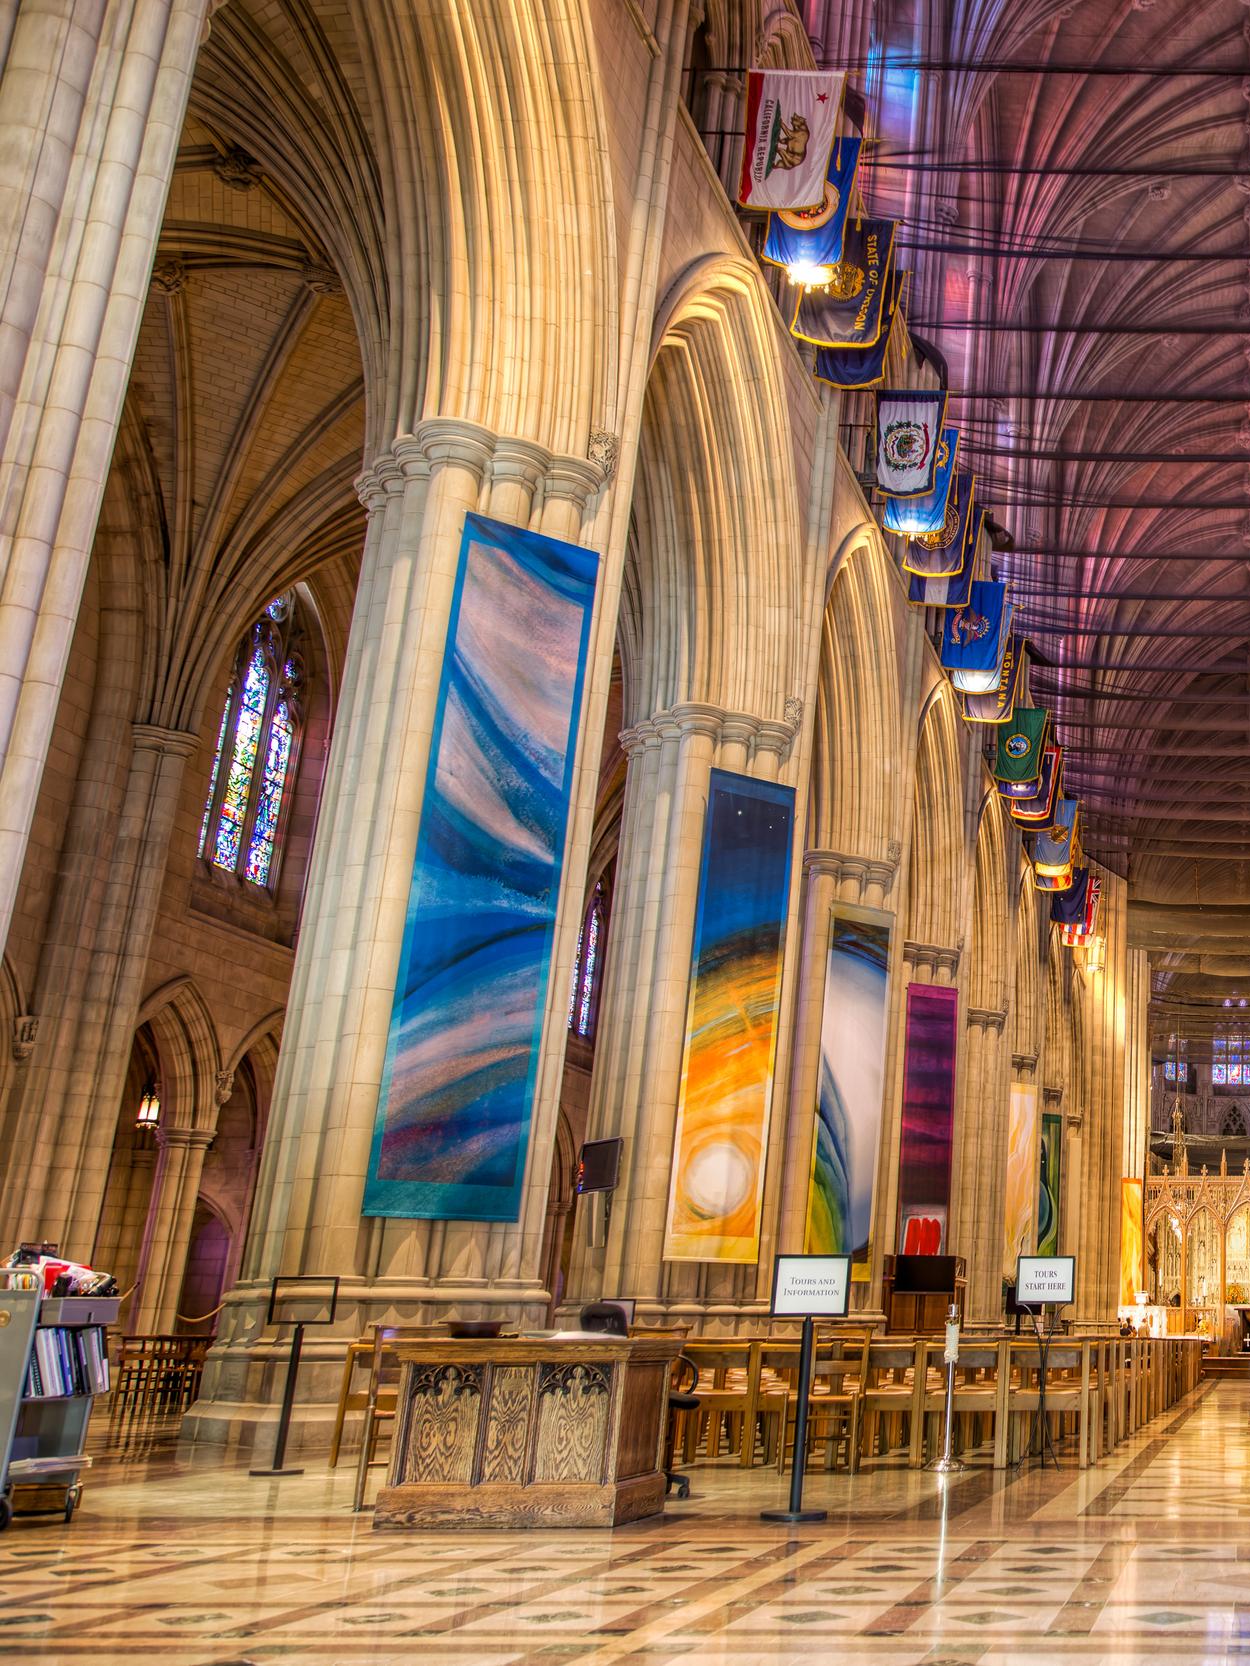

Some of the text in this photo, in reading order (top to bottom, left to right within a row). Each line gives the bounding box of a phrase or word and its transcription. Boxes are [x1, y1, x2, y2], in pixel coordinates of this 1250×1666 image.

[753, 99, 774, 184] CALIFORNIA REPUBLIC
[867, 234, 879, 267] STATE
[869, 269, 879, 286] OF
[997, 651, 1012, 708] MONTANA
[1025, 1282, 1067, 1291] START HERE
[1034, 1270, 1058, 1278] TOURS
